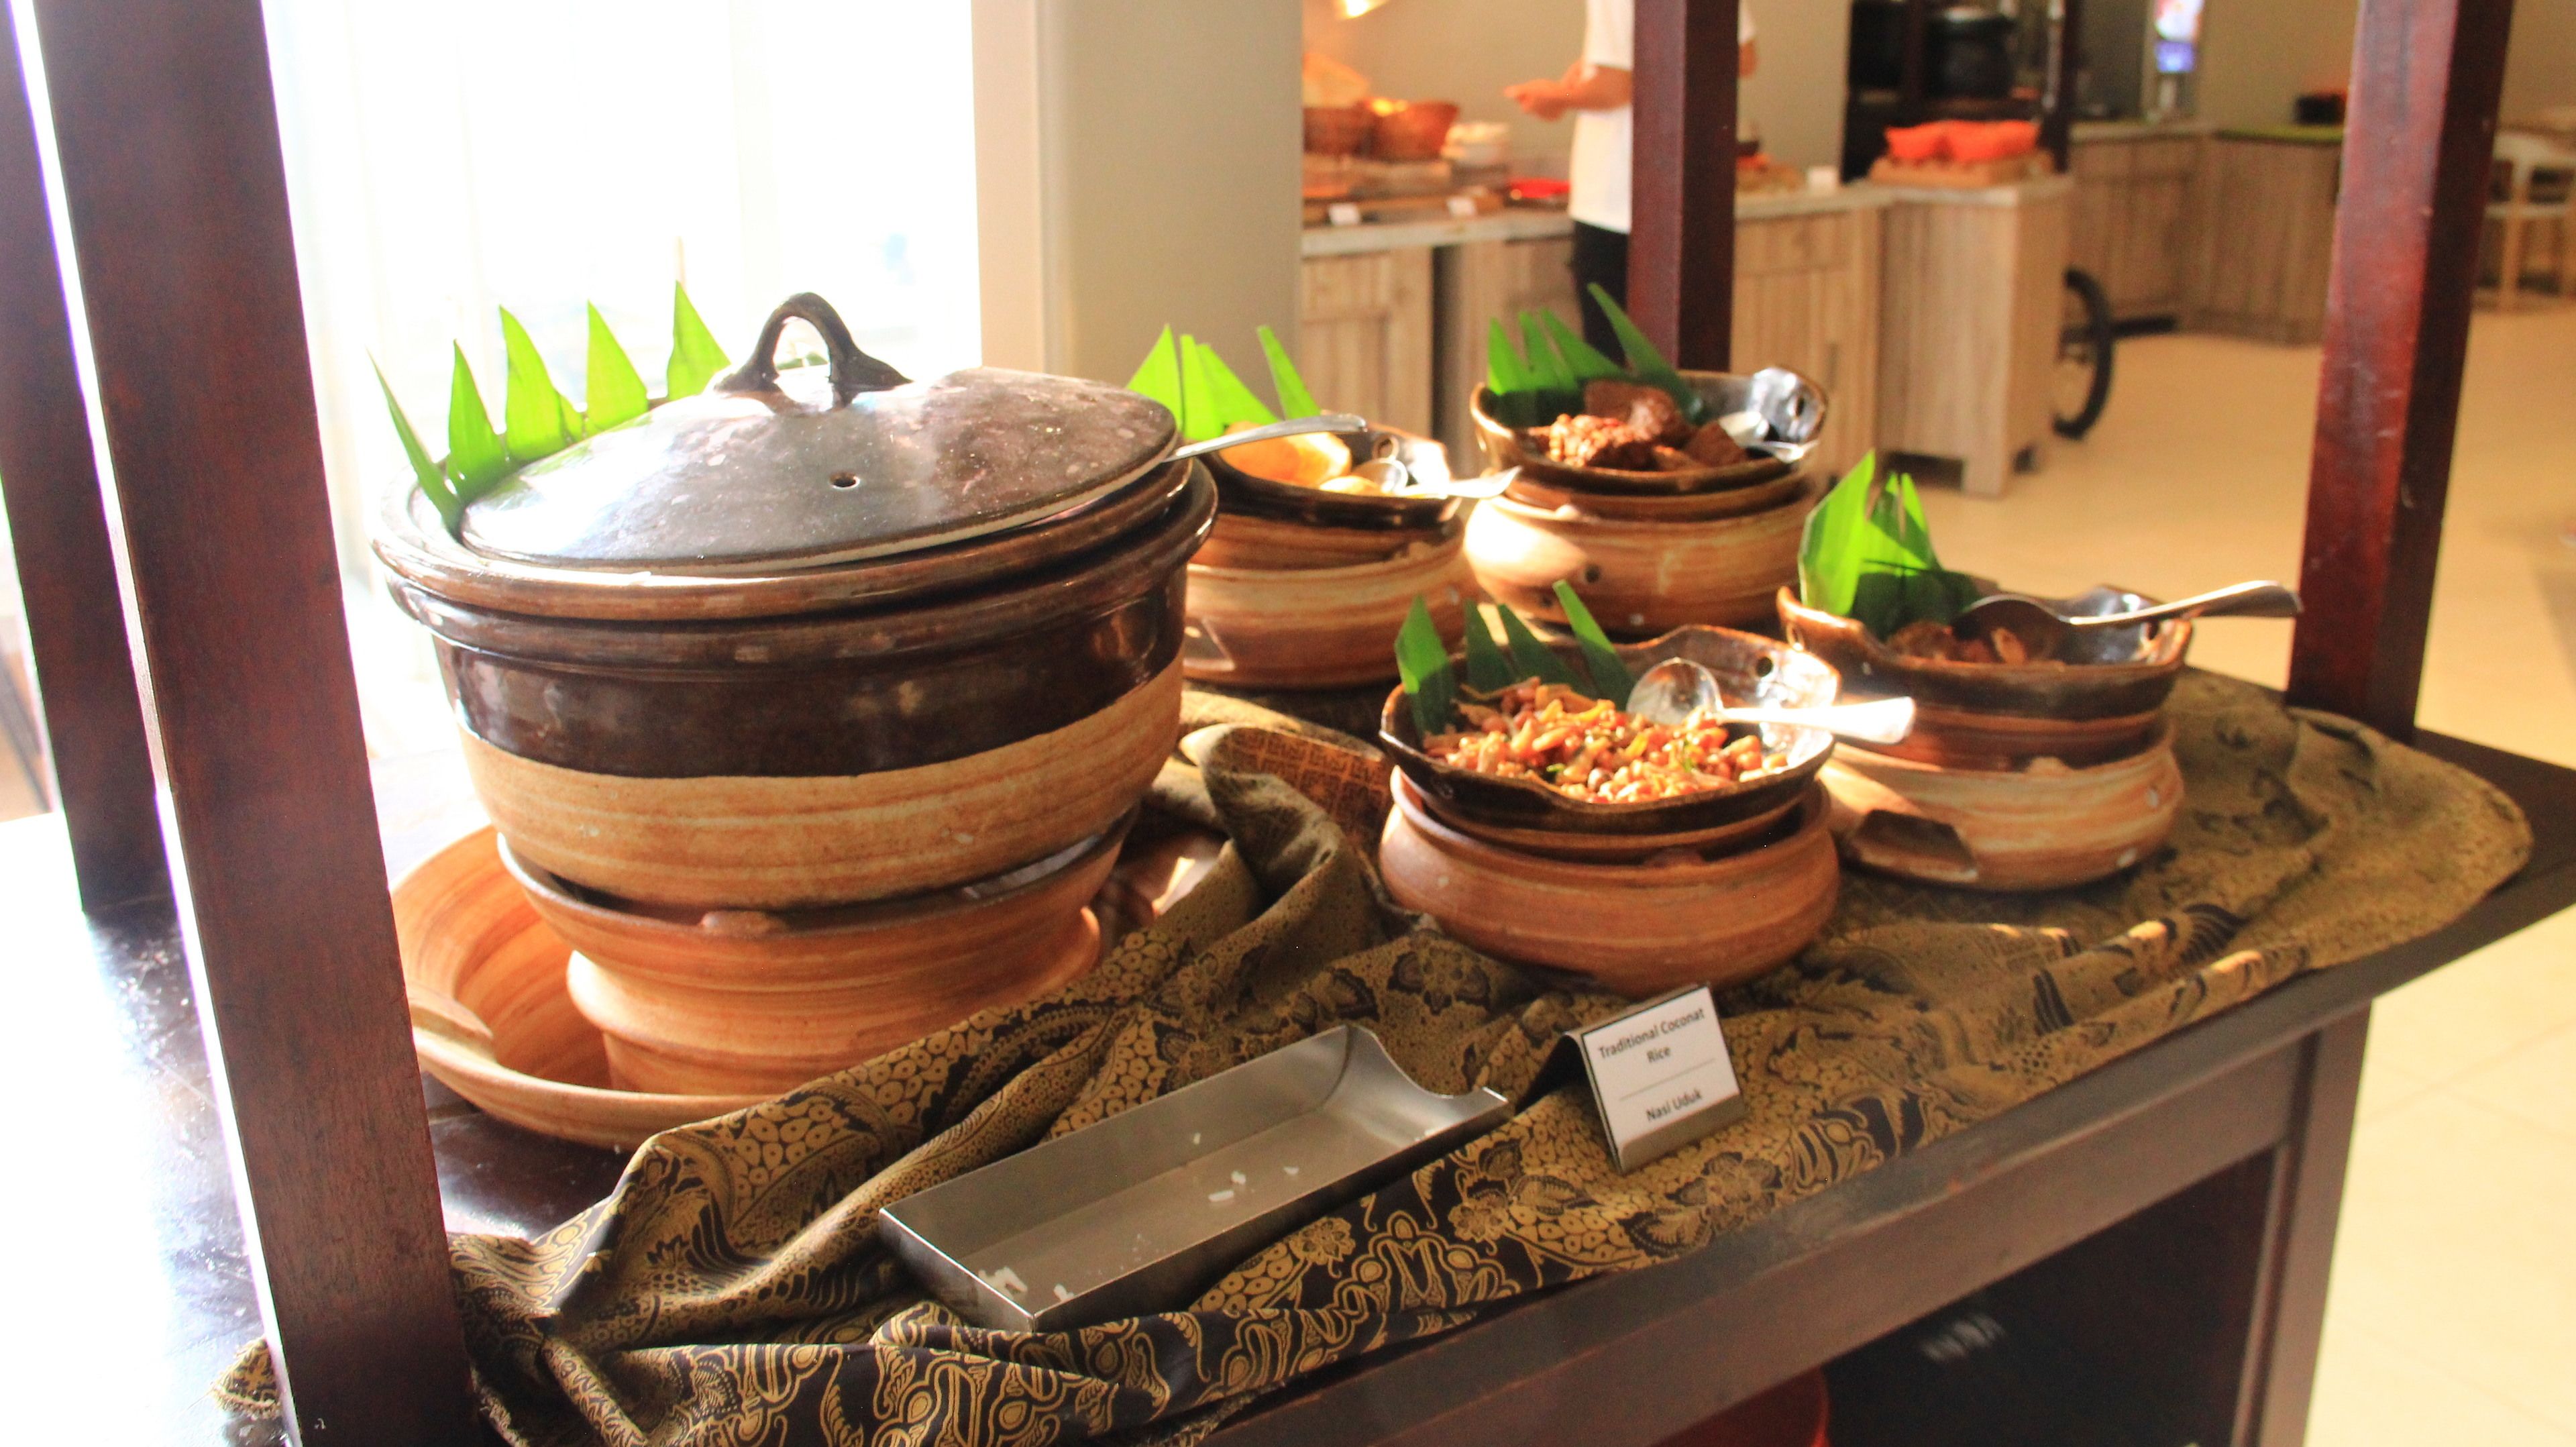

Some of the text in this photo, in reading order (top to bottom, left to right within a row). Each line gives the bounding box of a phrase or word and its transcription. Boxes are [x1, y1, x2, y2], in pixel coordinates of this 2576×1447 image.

[1599, 1025, 1659, 1059] Traditional
[1646, 1047, 1671, 1063] Rice
[1646, 1088, 1702, 1121] Nasi Uduk
